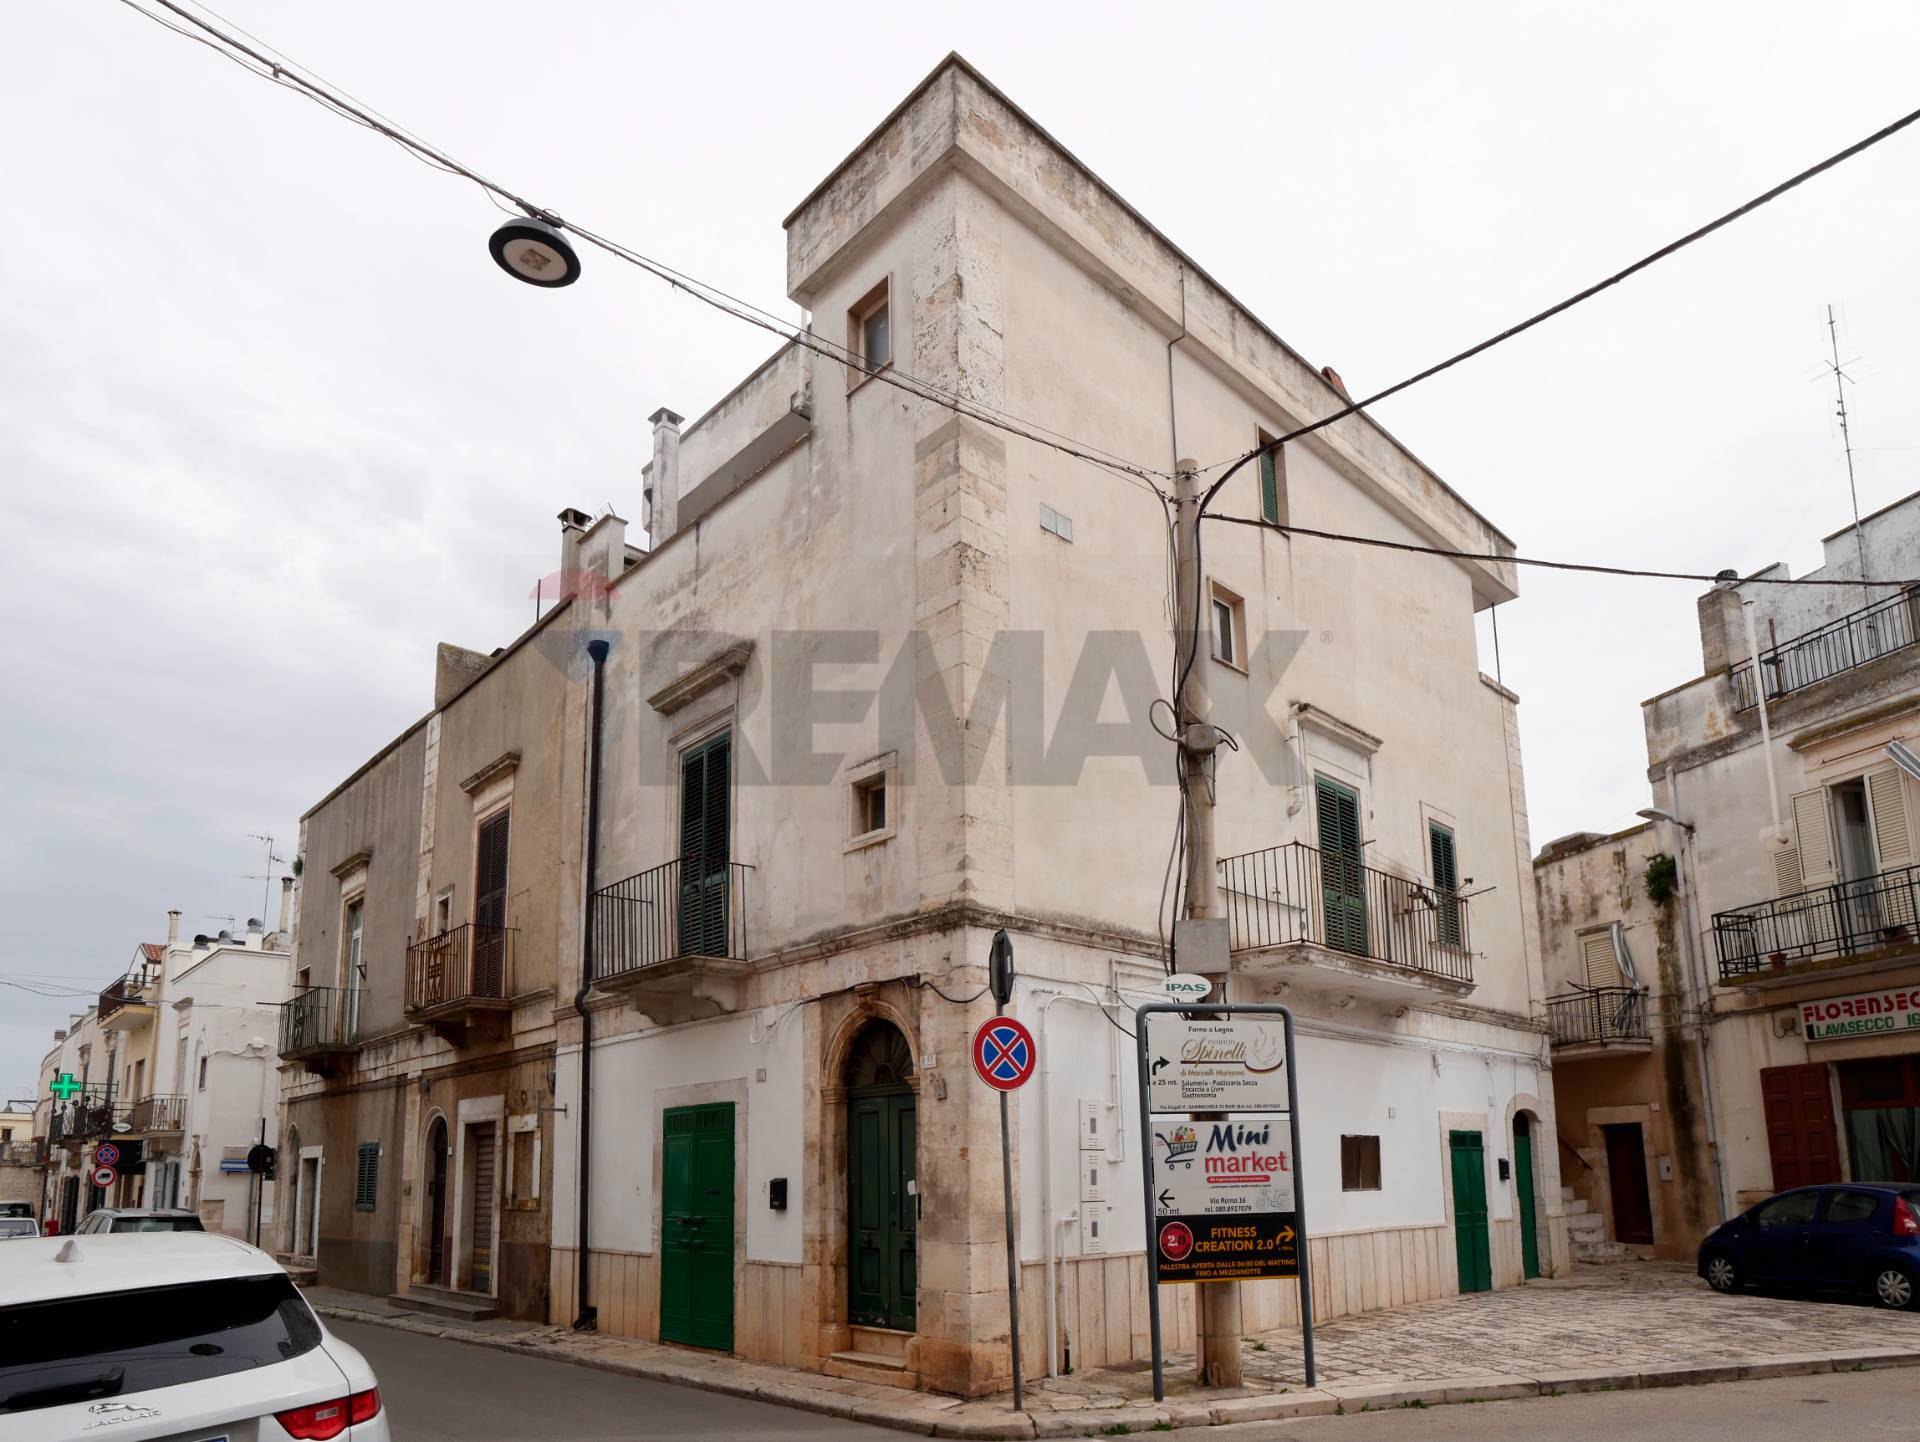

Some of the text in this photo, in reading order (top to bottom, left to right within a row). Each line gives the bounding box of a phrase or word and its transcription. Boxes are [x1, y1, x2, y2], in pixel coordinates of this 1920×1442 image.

[1165, 983, 1207, 992] IPAS
[1214, 1026, 1234, 1034] Legna
[1816, 1015, 1895, 1037] LAVASECCO
[1181, 1036, 1247, 1068] Spinelli
[1212, 1079, 1242, 1087] Pasticceria
[1181, 1091, 1217, 1099] Gastronomia
[1206, 1123, 1270, 1153] Mini
[1205, 1150, 1288, 1173] market
[1209, 1196, 1220, 1205] Via
[1220, 1196, 1239, 1204] Roma
[1157, 1207, 1168, 1216] 50
[1210, 1226, 1257, 1239] FITNESS
[1194, 1239, 1254, 1253] CREATION
[1256, 1239, 1274, 1250] 2.0
[1160, 1262, 1191, 1271] PALESTRA
[1191, 1261, 1216, 1270] APERTA
[1216, 1260, 1237, 1269] DALLE
[1267, 1258, 1296, 1267] MATTINO
[1195, 1269, 1212, 1277] FINO
[1218, 1267, 1262, 1276] MEZZANOTTE
[82, 1409, 162, 1431] JAGUAR
